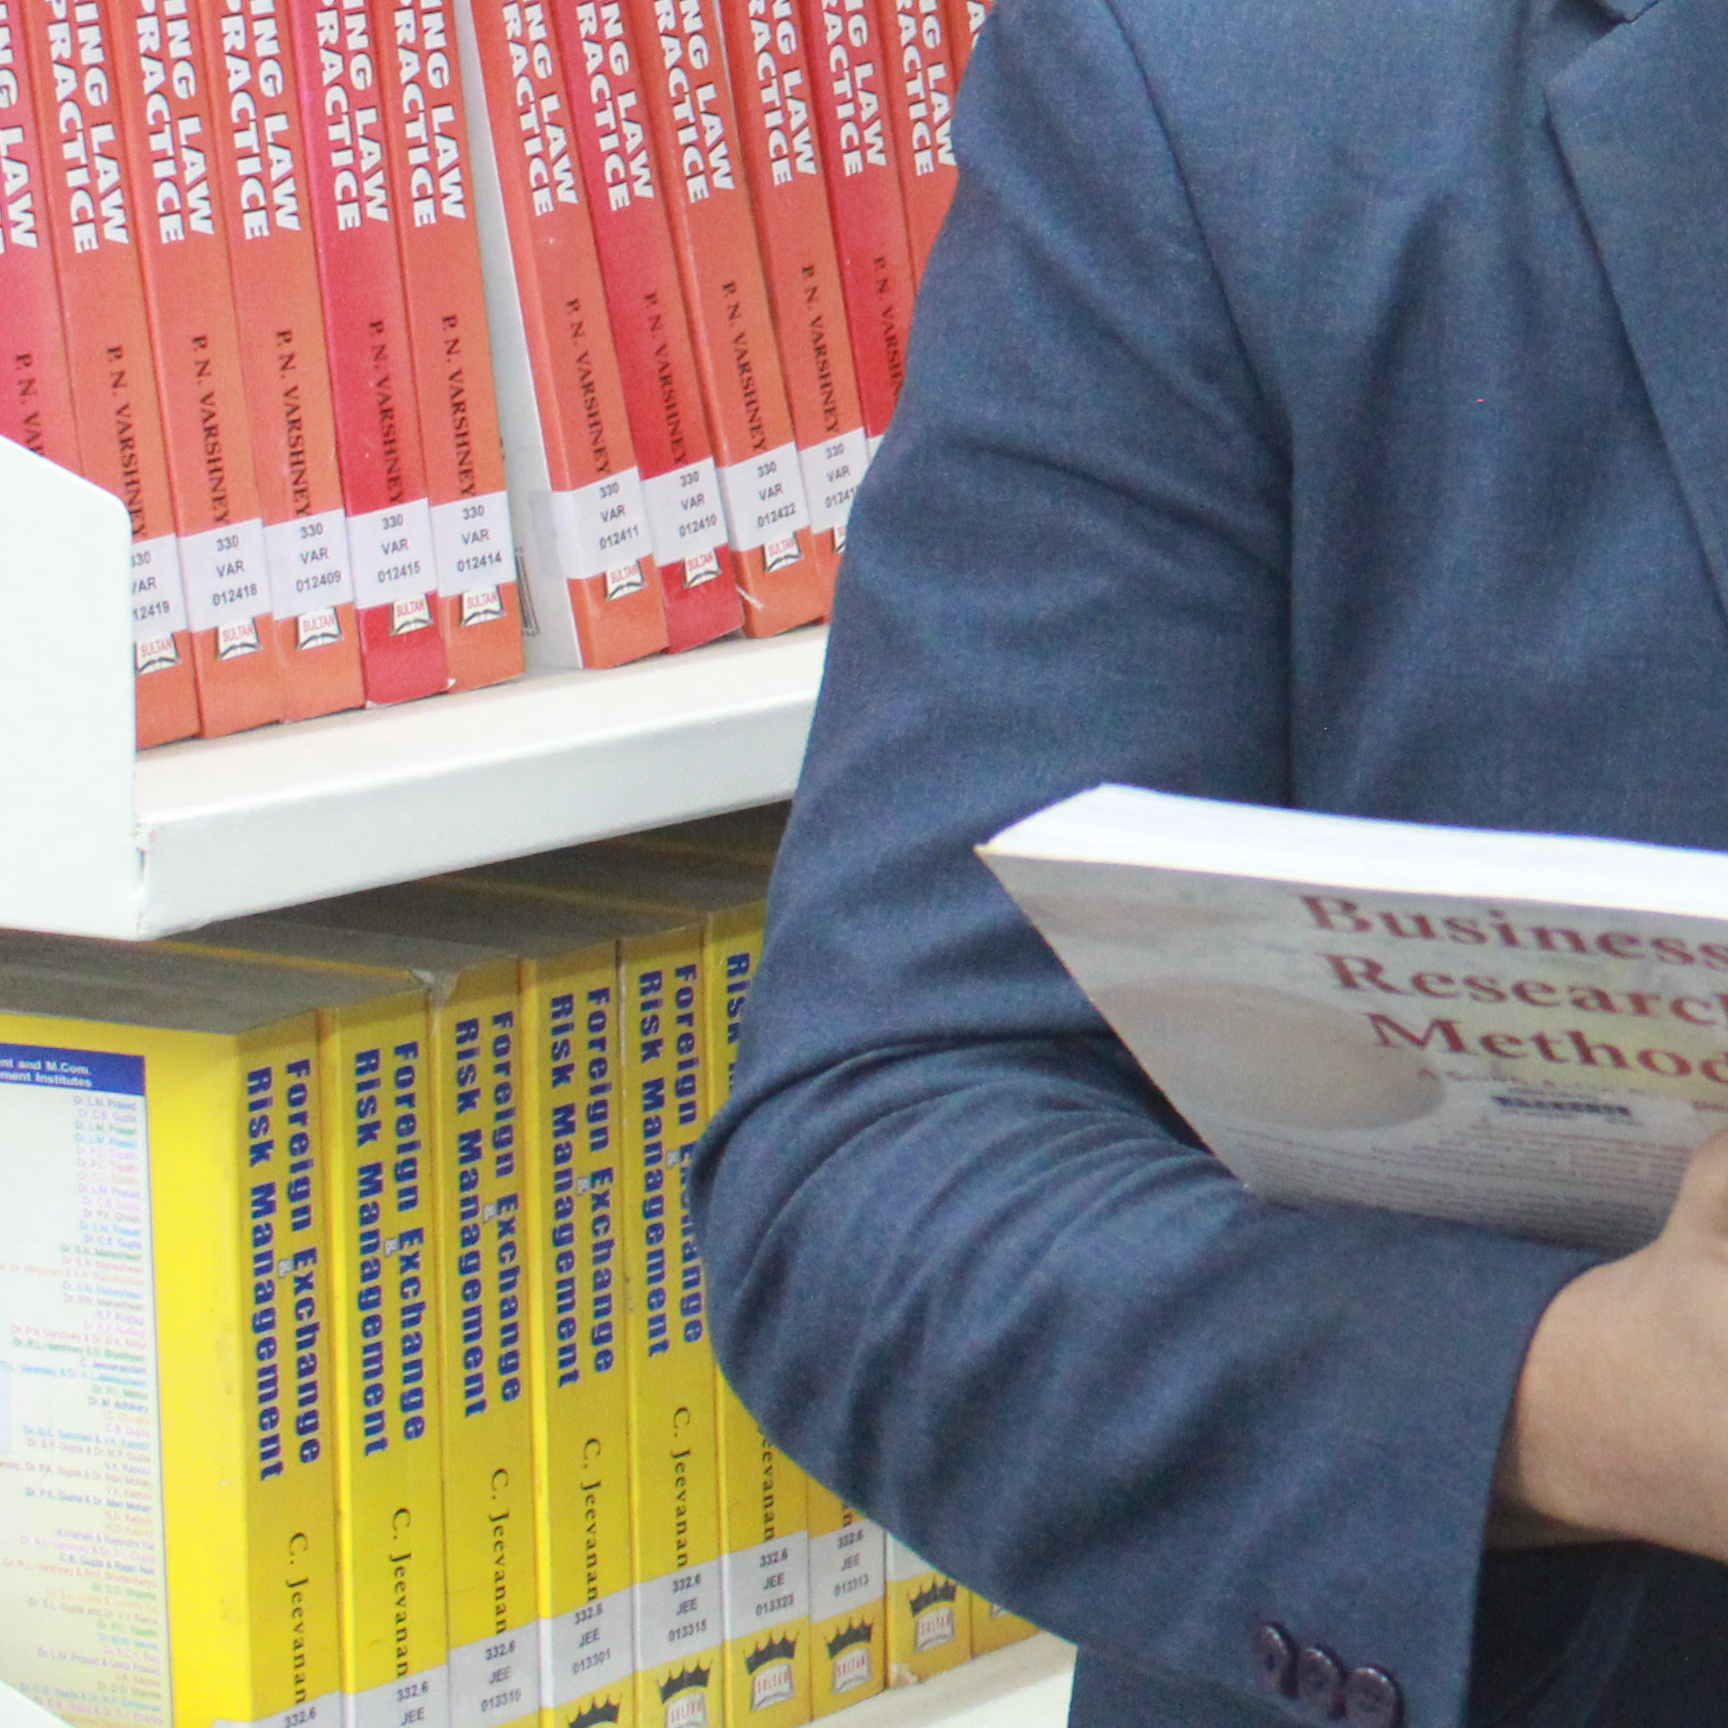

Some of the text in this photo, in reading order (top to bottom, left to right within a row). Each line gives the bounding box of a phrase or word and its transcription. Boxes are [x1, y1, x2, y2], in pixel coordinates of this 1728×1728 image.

[853, 63, 888, 167] LAW
[90, 123, 129, 245] LAW
[264, 112, 301, 232] LAW
[200, 391, 230, 524] VARSHNEY
[462, 504, 486, 520] 330
[216, 534, 239, 551] 330
[461, 528, 491, 544] VAR
[216, 559, 246, 577] VAR
[456, 551, 503, 574] 012414
[465, 590, 498, 610] SULTAN
[550, 993, 582, 1388] Risk Management
[587, 987, 616, 1373] Foreign Exchange
[247, 1066, 284, 1482] Risk Management
[286, 1058, 321, 1464] Foreign Exchange
[491, 1466, 509, 1505] C.
[671, 1574, 703, 1594] 332.6
[675, 1596, 698, 1615] JEE
